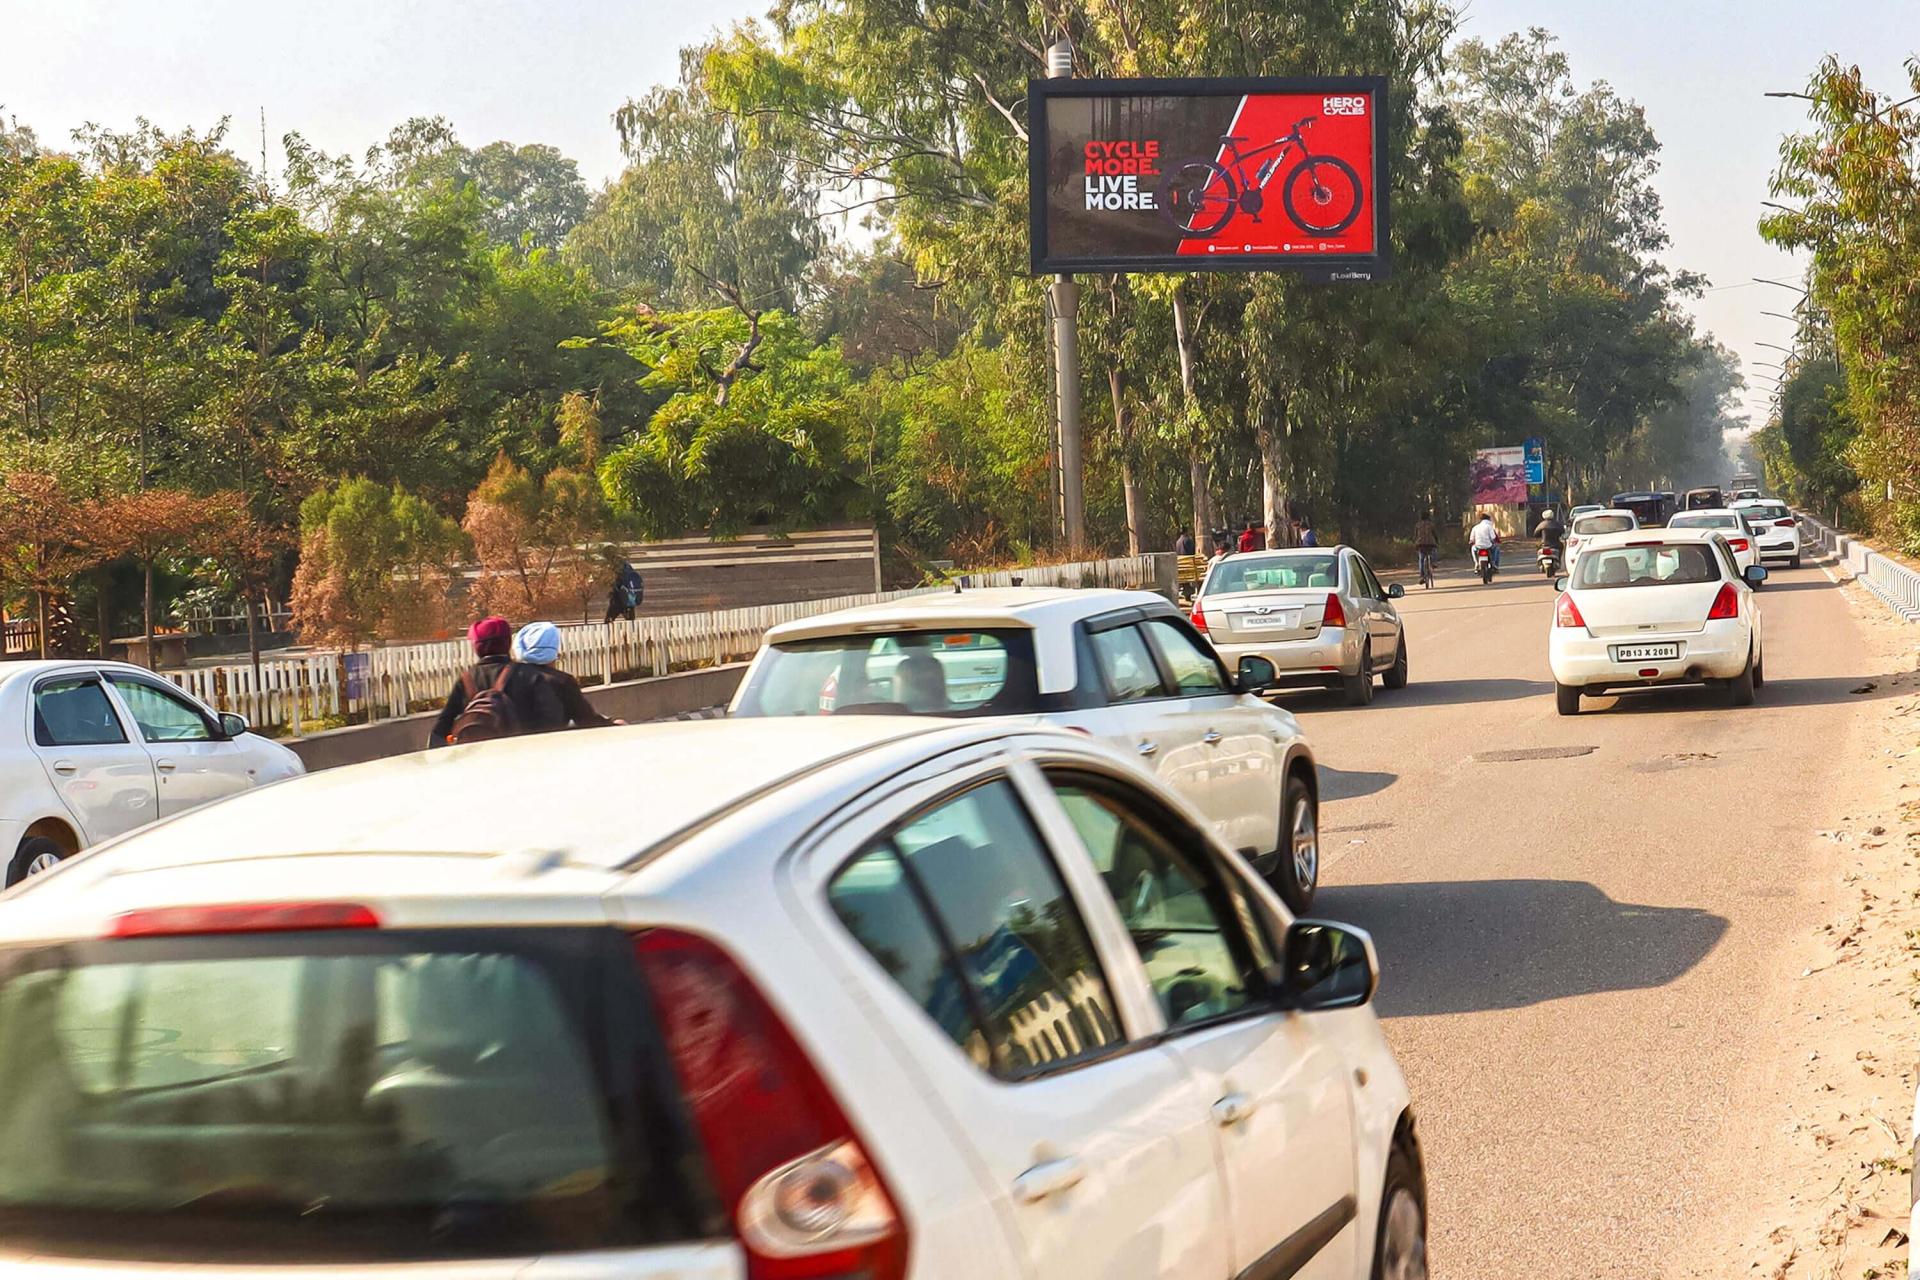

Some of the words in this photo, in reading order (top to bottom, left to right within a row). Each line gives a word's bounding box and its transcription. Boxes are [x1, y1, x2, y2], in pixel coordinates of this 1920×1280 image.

[1323, 96, 1365, 107] HERO
[1323, 107, 1365, 116] CYCLES
[1084, 140, 1160, 159] CYCLE
[1085, 158, 1161, 176] MORE.
[1085, 175, 1138, 193] LIVE
[1085, 192, 1159, 211] MORE.
[1645, 648, 1651, 656] X
